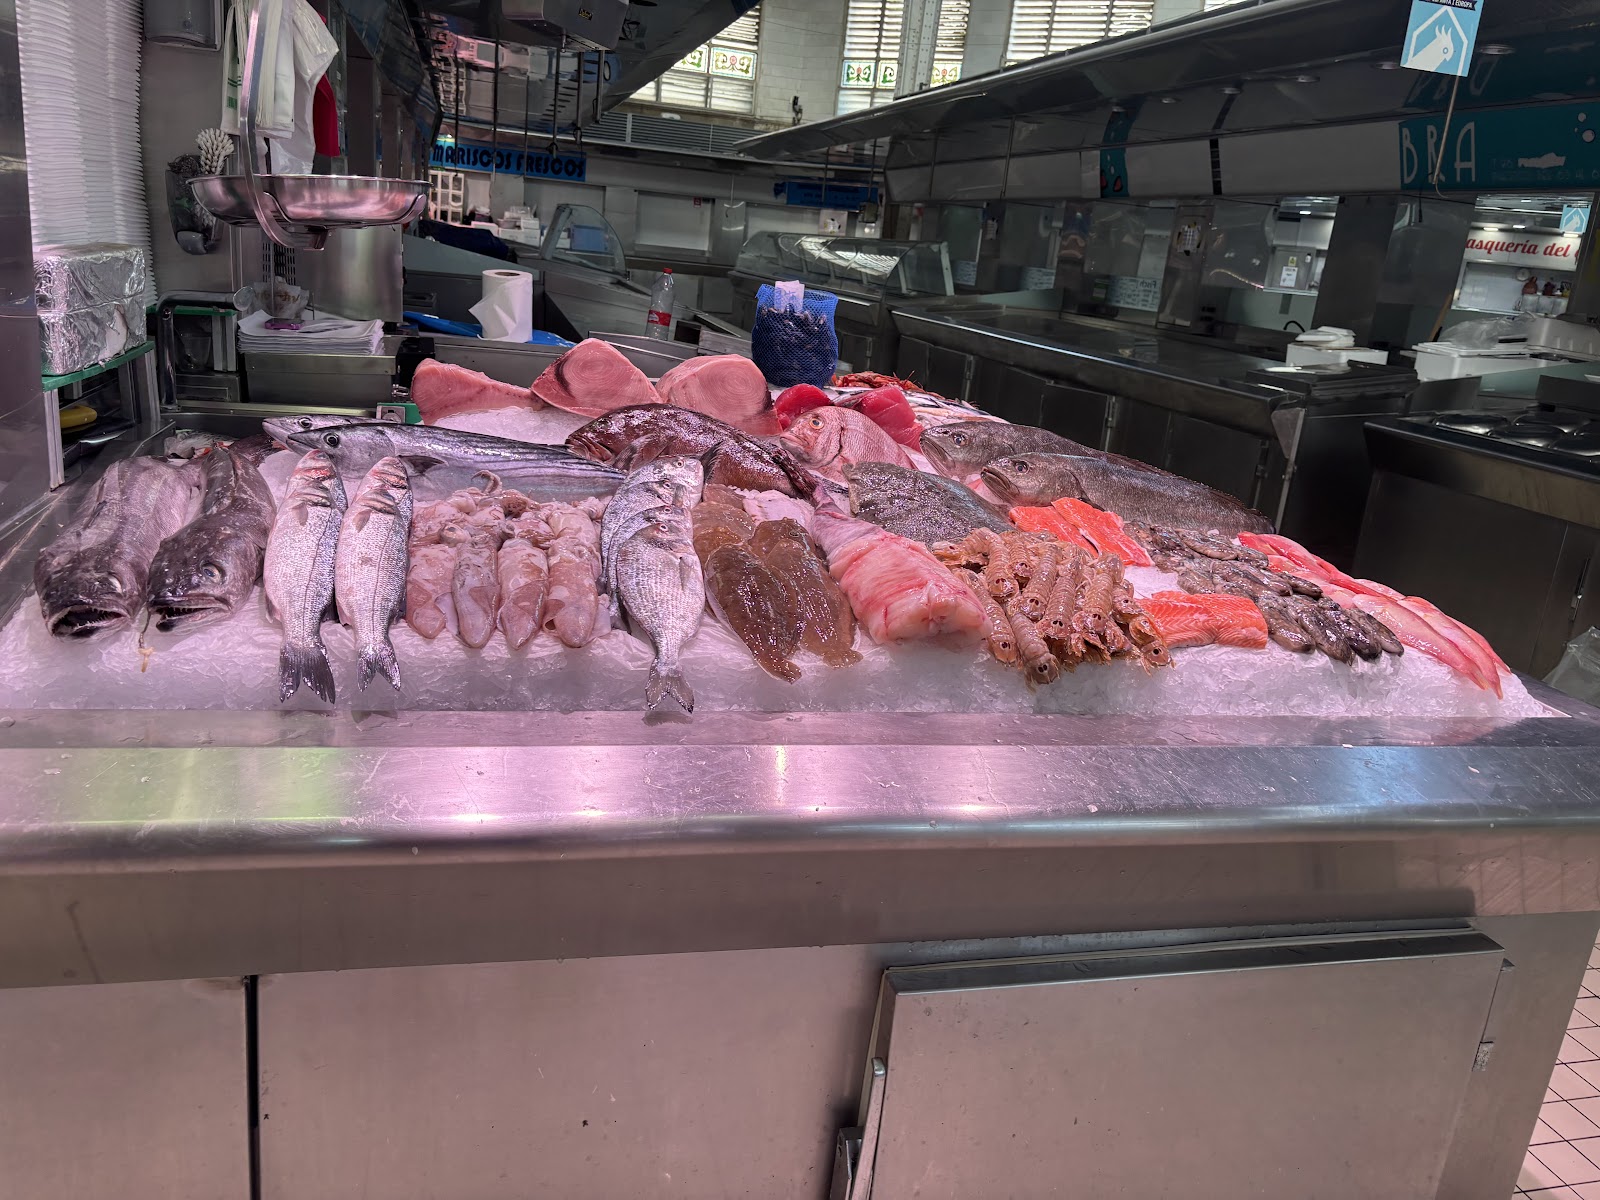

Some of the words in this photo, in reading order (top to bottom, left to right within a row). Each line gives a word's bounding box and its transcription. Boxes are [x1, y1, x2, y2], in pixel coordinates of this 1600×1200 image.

[432, 144, 511, 170] MARISCOS
[516, 153, 585, 177] FRESCOS
[1402, 121, 1476, 184] BRA
[1465, 238, 1540, 255] asquería
[1543, 242, 1571, 258] del
